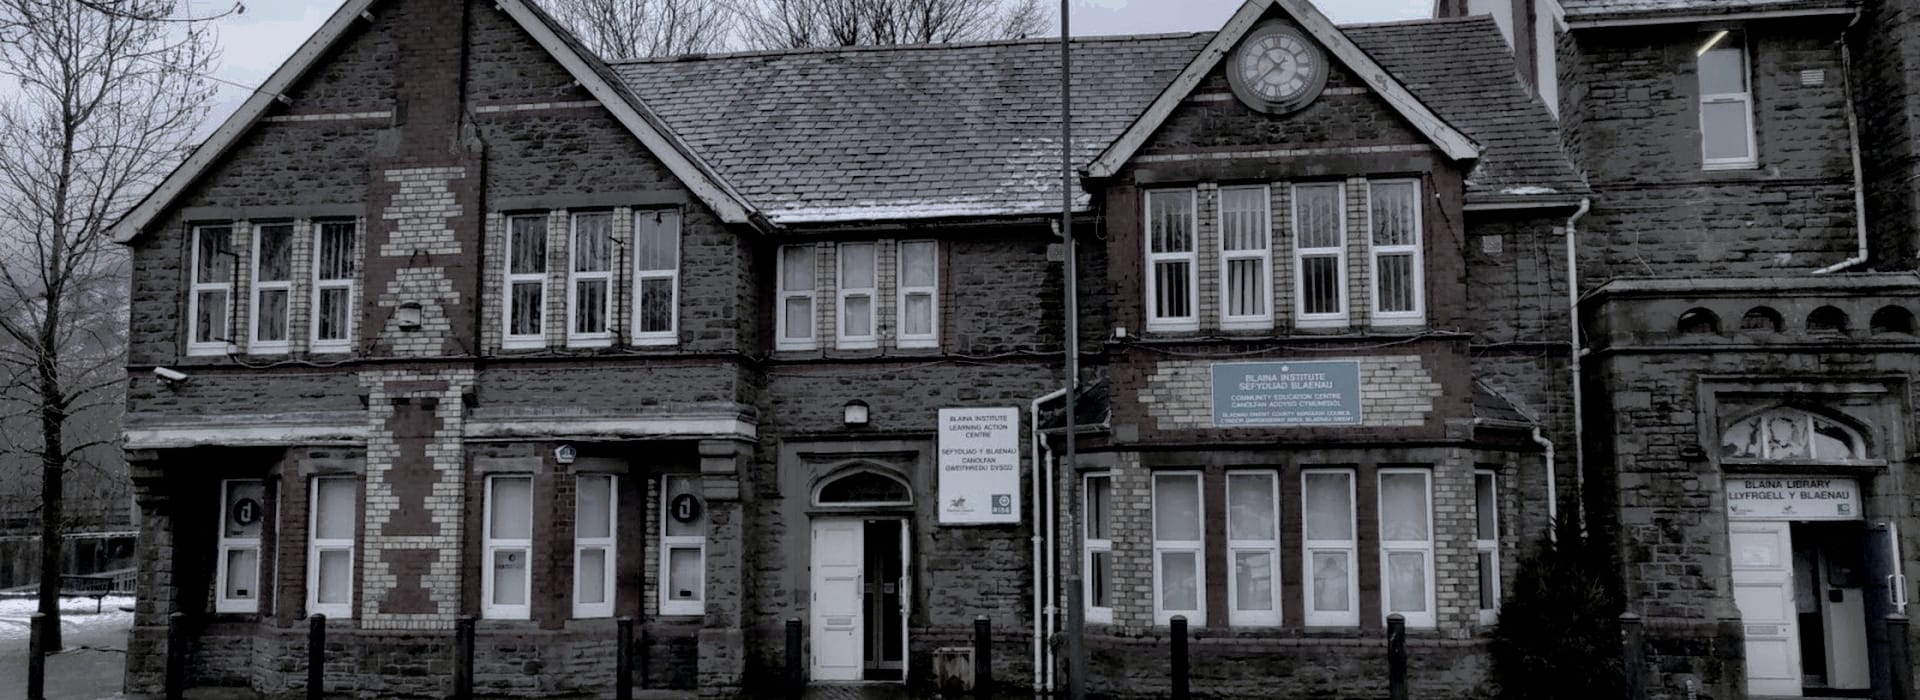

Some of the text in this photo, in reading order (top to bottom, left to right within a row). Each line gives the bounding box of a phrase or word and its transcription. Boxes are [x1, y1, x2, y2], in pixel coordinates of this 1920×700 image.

[1280, 373, 1326, 381] INSTITUTE
[1291, 382, 1332, 390] BLAENAU
[1744, 480, 1831, 488] BLAINA LIBRARY
[1728, 491, 1850, 500] LLYFRGELL Y BLAENAU
